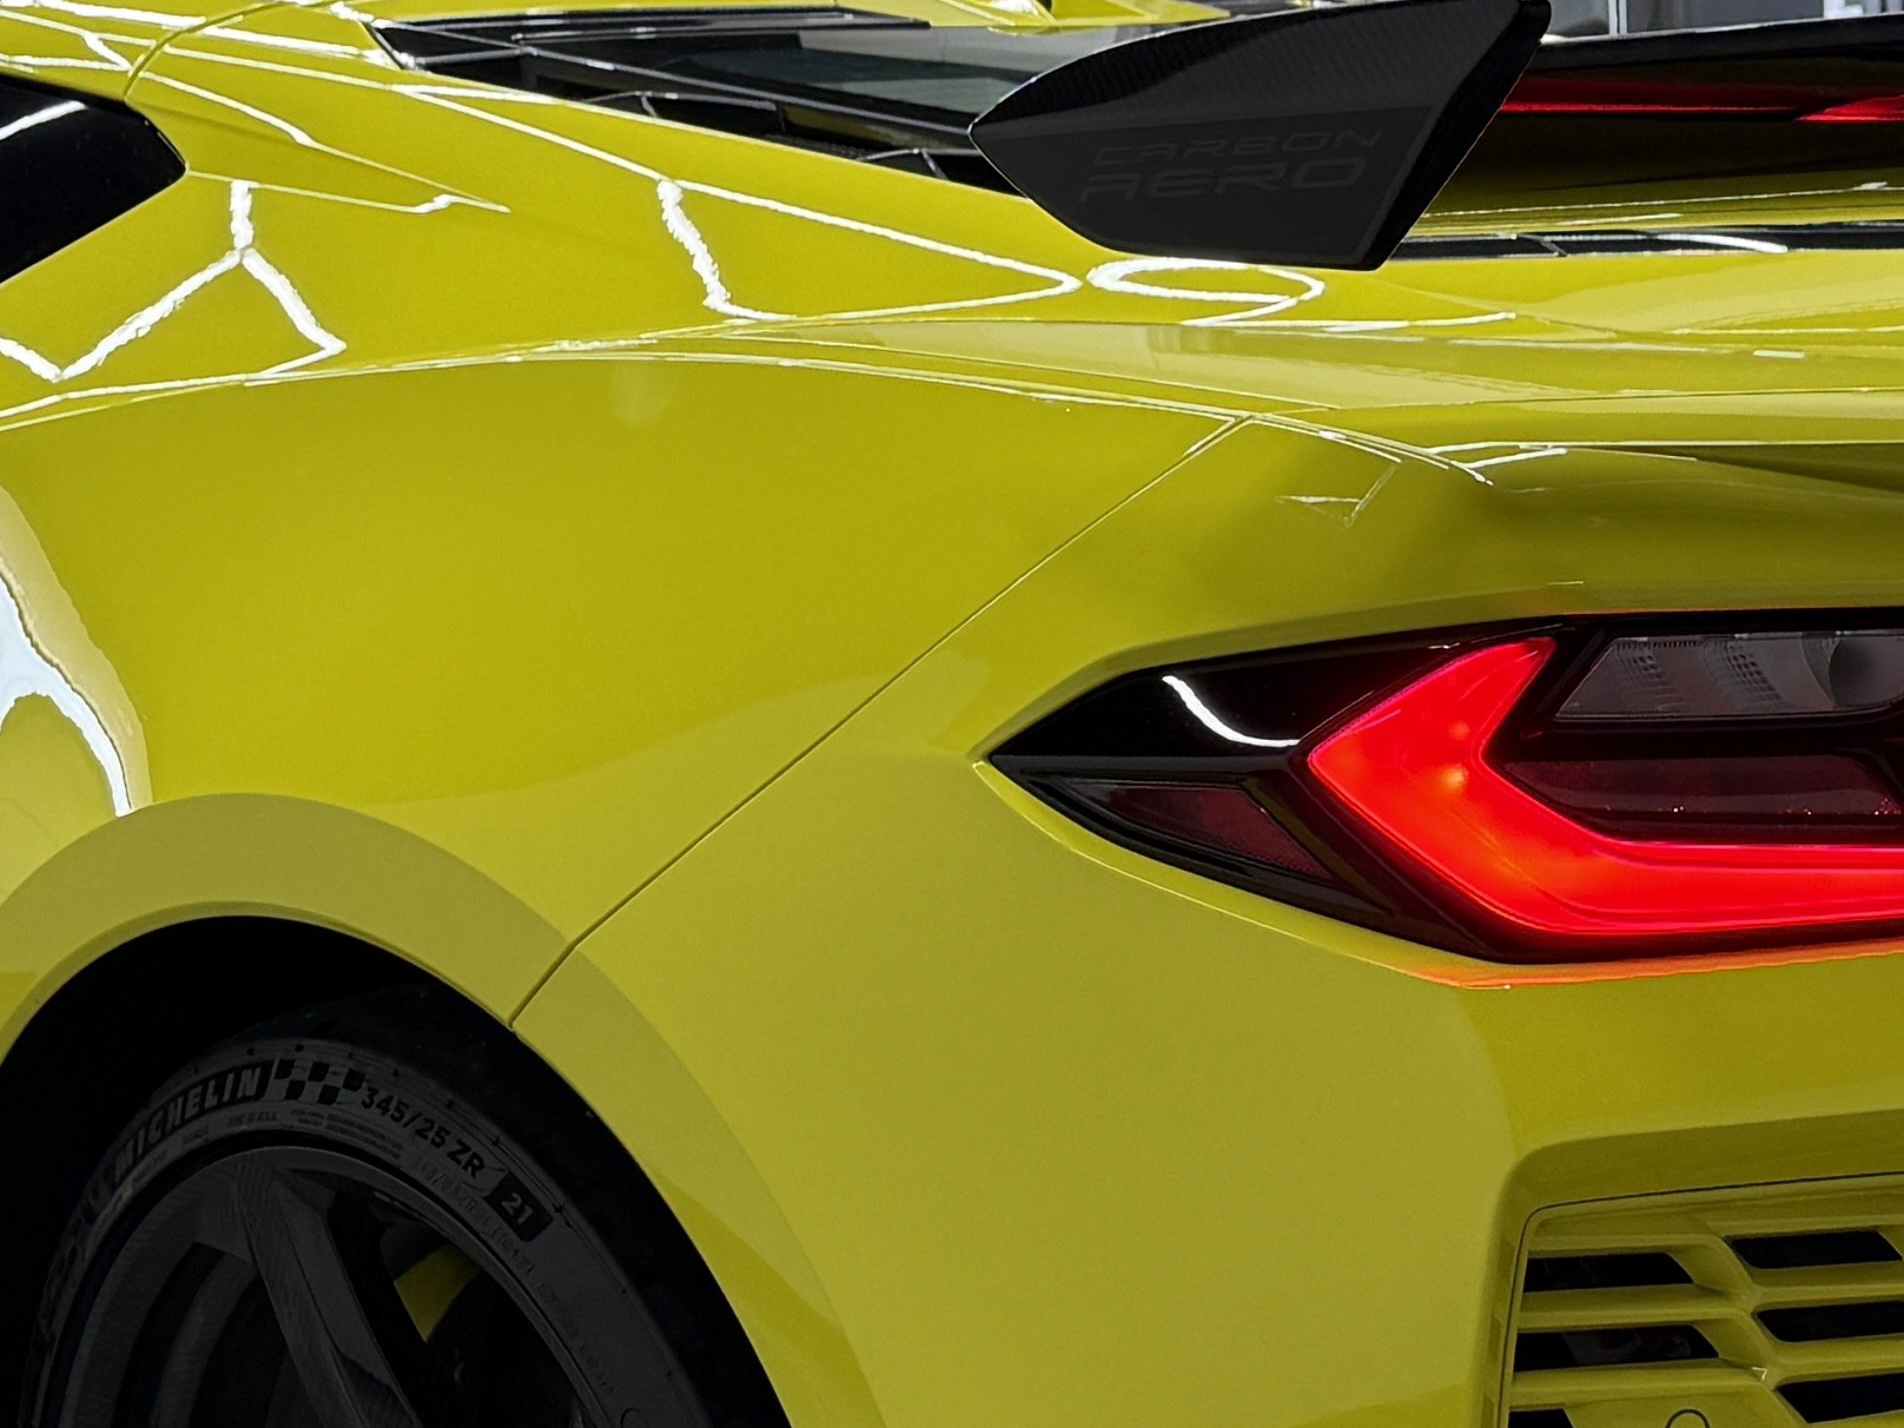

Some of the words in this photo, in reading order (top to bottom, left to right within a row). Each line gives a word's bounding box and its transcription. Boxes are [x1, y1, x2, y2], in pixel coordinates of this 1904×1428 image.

[1094, 128, 1382, 165] CARBON
[1078, 156, 1367, 204] AERO
[114, 1065, 264, 1181] MICHELIN
[361, 1085, 451, 1149] 345/25
[447, 1138, 488, 1179] ZR
[499, 1191, 534, 1225] 21
